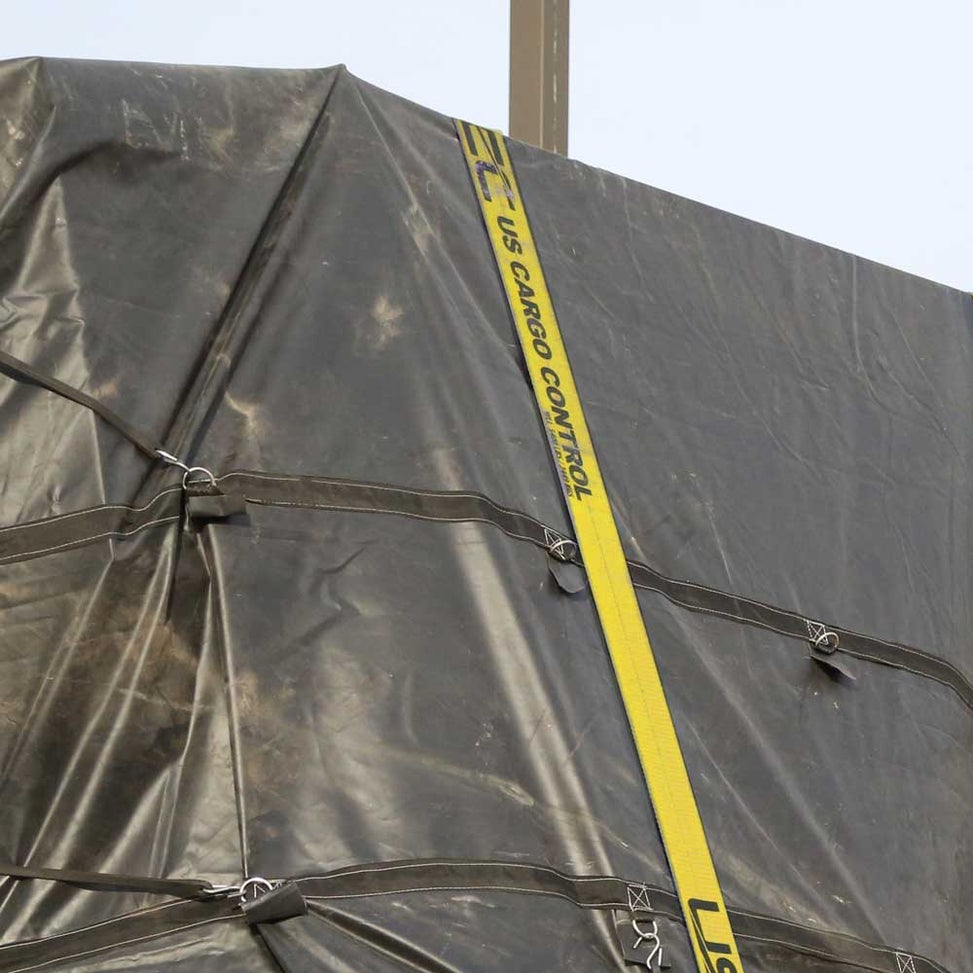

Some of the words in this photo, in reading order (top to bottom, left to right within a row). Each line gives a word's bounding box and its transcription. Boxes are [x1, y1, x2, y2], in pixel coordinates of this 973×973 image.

[497, 216, 523, 255] US
[510, 261, 552, 361] CARGO
[540, 367, 593, 501] CONTROL
